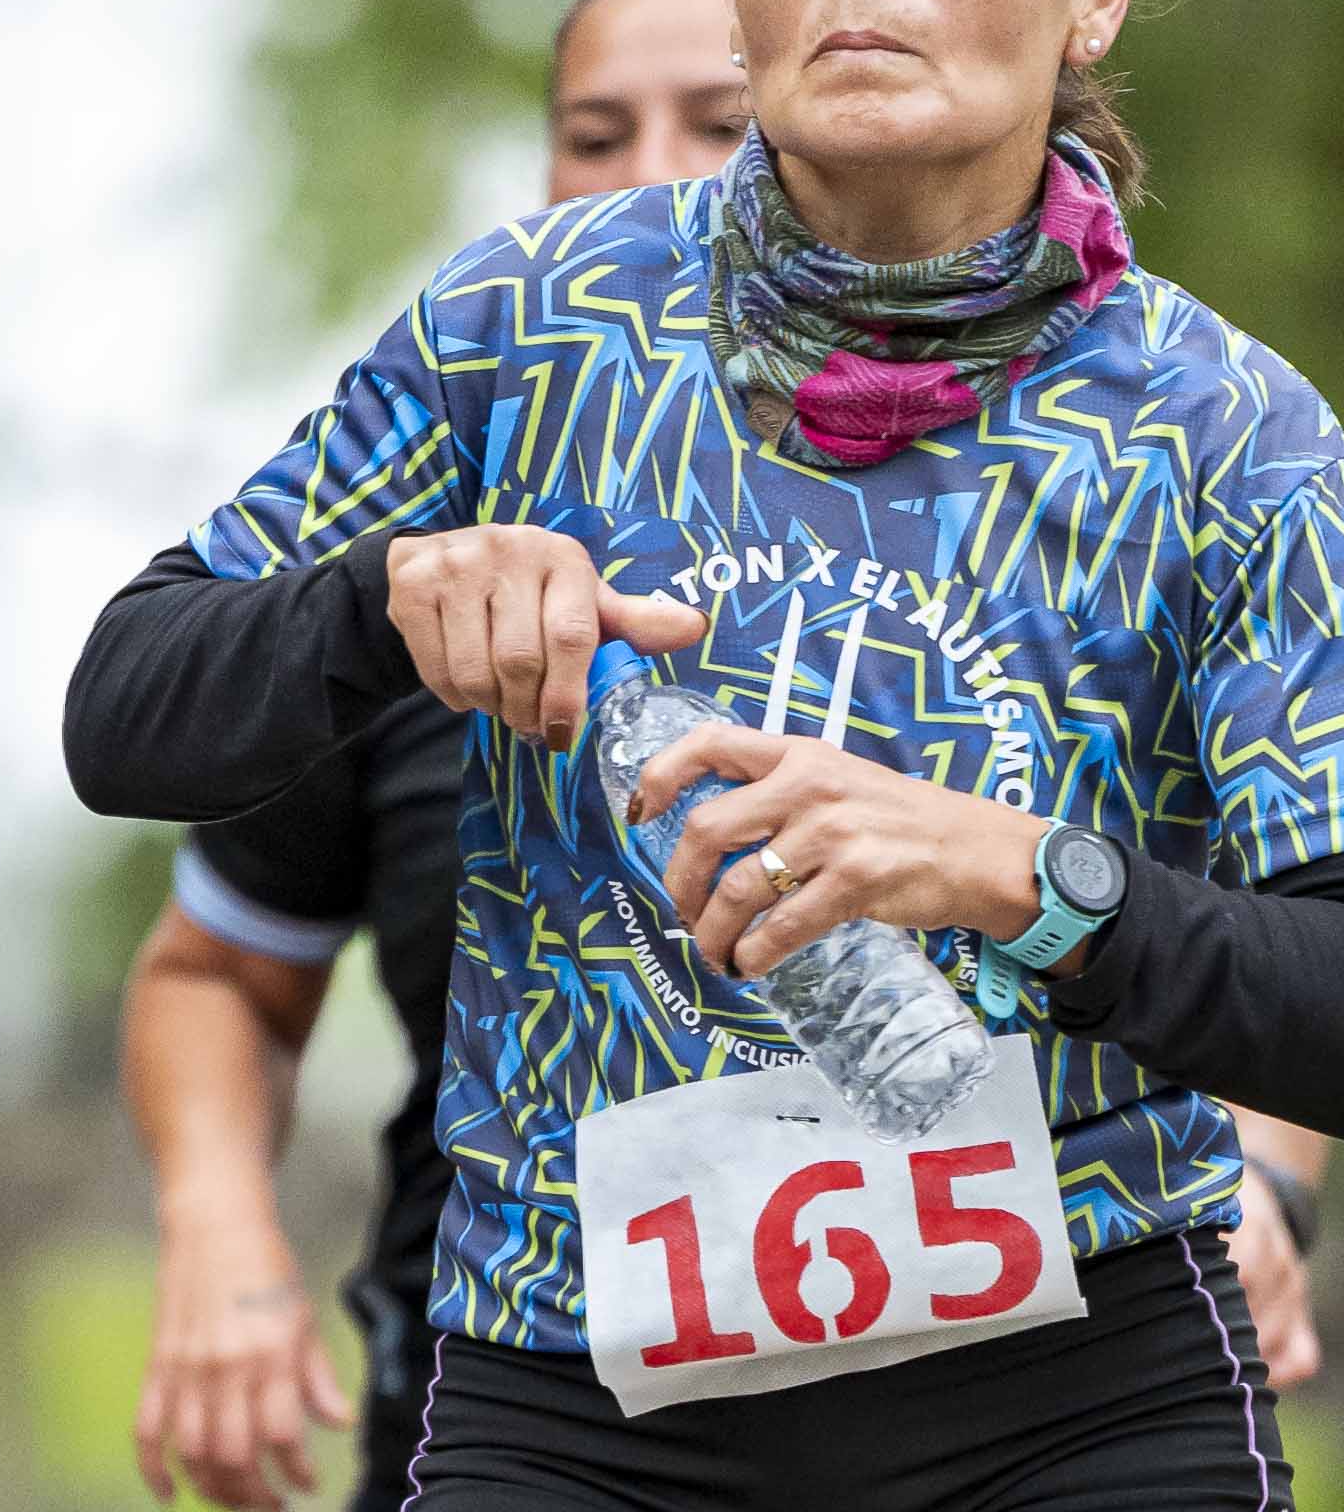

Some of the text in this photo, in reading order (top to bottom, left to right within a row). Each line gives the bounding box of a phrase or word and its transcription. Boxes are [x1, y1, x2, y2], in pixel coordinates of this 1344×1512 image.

[799, 545, 841, 587] X
[849, 557, 902, 612] EL
[905, 599, 1034, 814] AUTISMO
[607, 880, 701, 1035] MOVIMIENTO,
[626, 1141, 1043, 1369] 165
